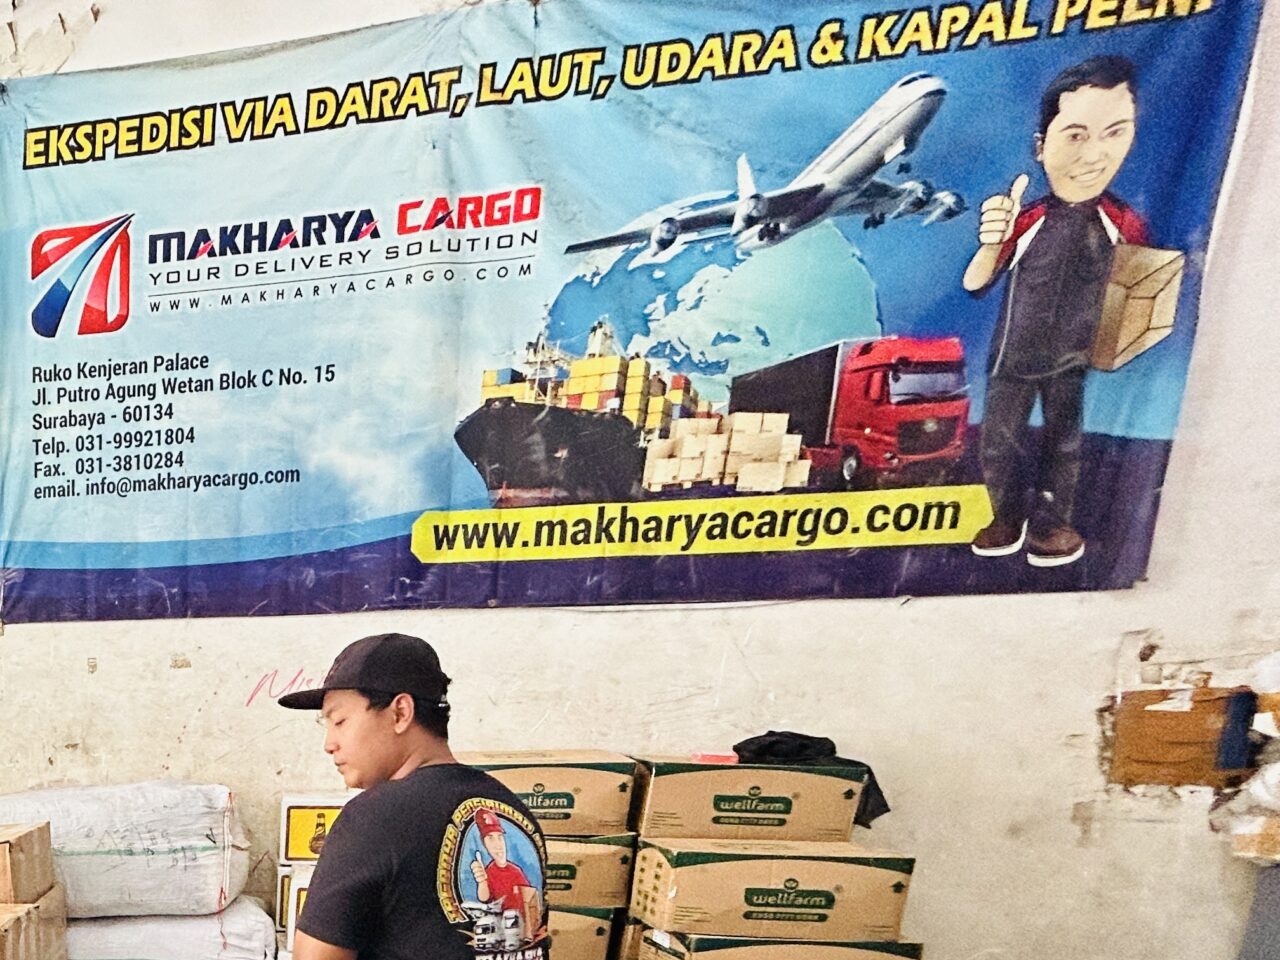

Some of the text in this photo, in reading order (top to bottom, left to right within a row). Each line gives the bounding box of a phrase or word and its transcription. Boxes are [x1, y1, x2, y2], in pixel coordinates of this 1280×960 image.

[24, 0, 1214, 169] EKSPEDISI VIA DARAT, LAUT, UDARA & KAPAL PEL
[149, 187, 541, 264] MAKHARYA CARGO
[149, 229, 538, 286] YOUR DELIVERY SOLUTION
[150, 264, 533, 312] WWW.MAKHARYACARGO.COM
[32, 354, 209, 383] Ruko Kenjeran Palace
[32, 364, 336, 406] Jl. Putro Agung Wetan Blok C No. 15
[32, 410, 106, 431] Surabaya
[122, 404, 174, 423] 60134
[32, 427, 195, 456] Telp. 031-99921804
[34, 451, 184, 478] Fax. 031-3810284
[33, 466, 300, 500] email. info@makharyacargo.com
[432, 501, 960, 552] www.makharyacargo.com
[522, 796, 568, 807] ellfarm
[753, 893, 826, 905] wellfarm
